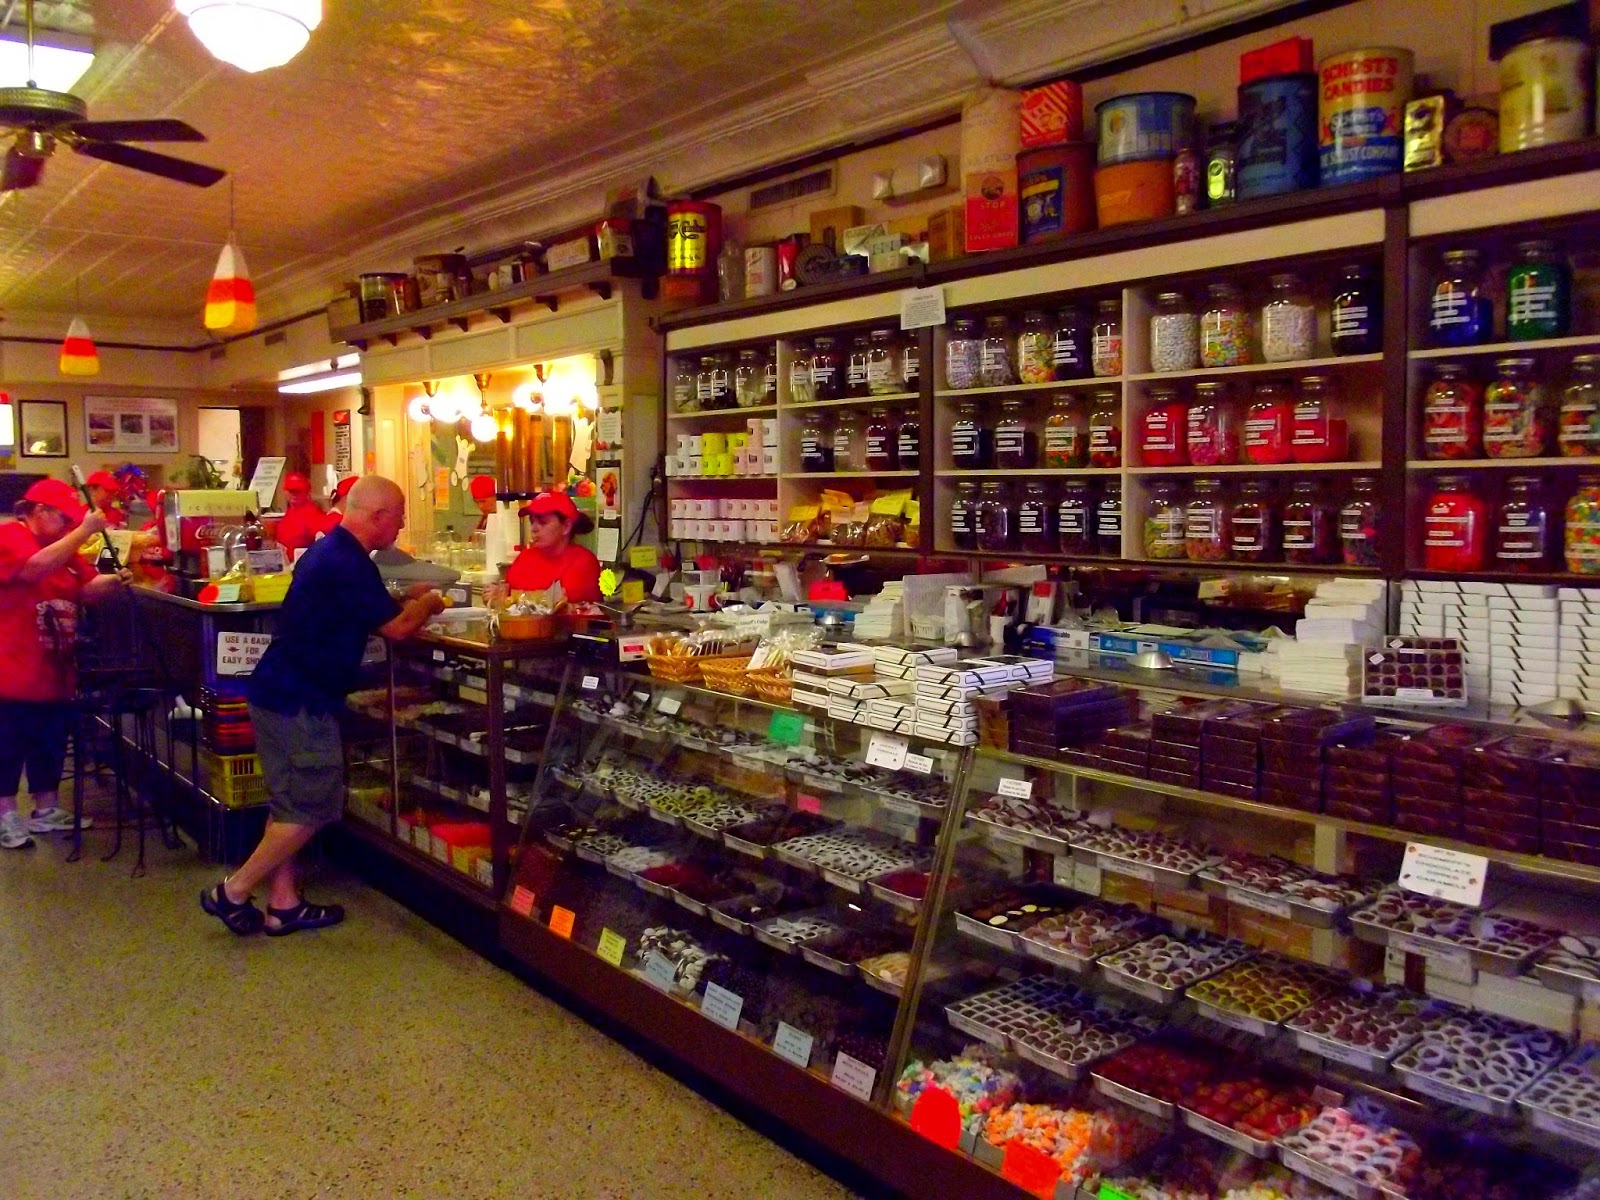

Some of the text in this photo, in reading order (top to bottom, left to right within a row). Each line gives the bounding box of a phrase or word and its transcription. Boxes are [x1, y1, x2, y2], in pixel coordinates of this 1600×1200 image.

[225, 635, 271, 645] USE A BASK
[245, 646, 260, 655] FOR
[222, 656, 260, 665] EASY SHO
